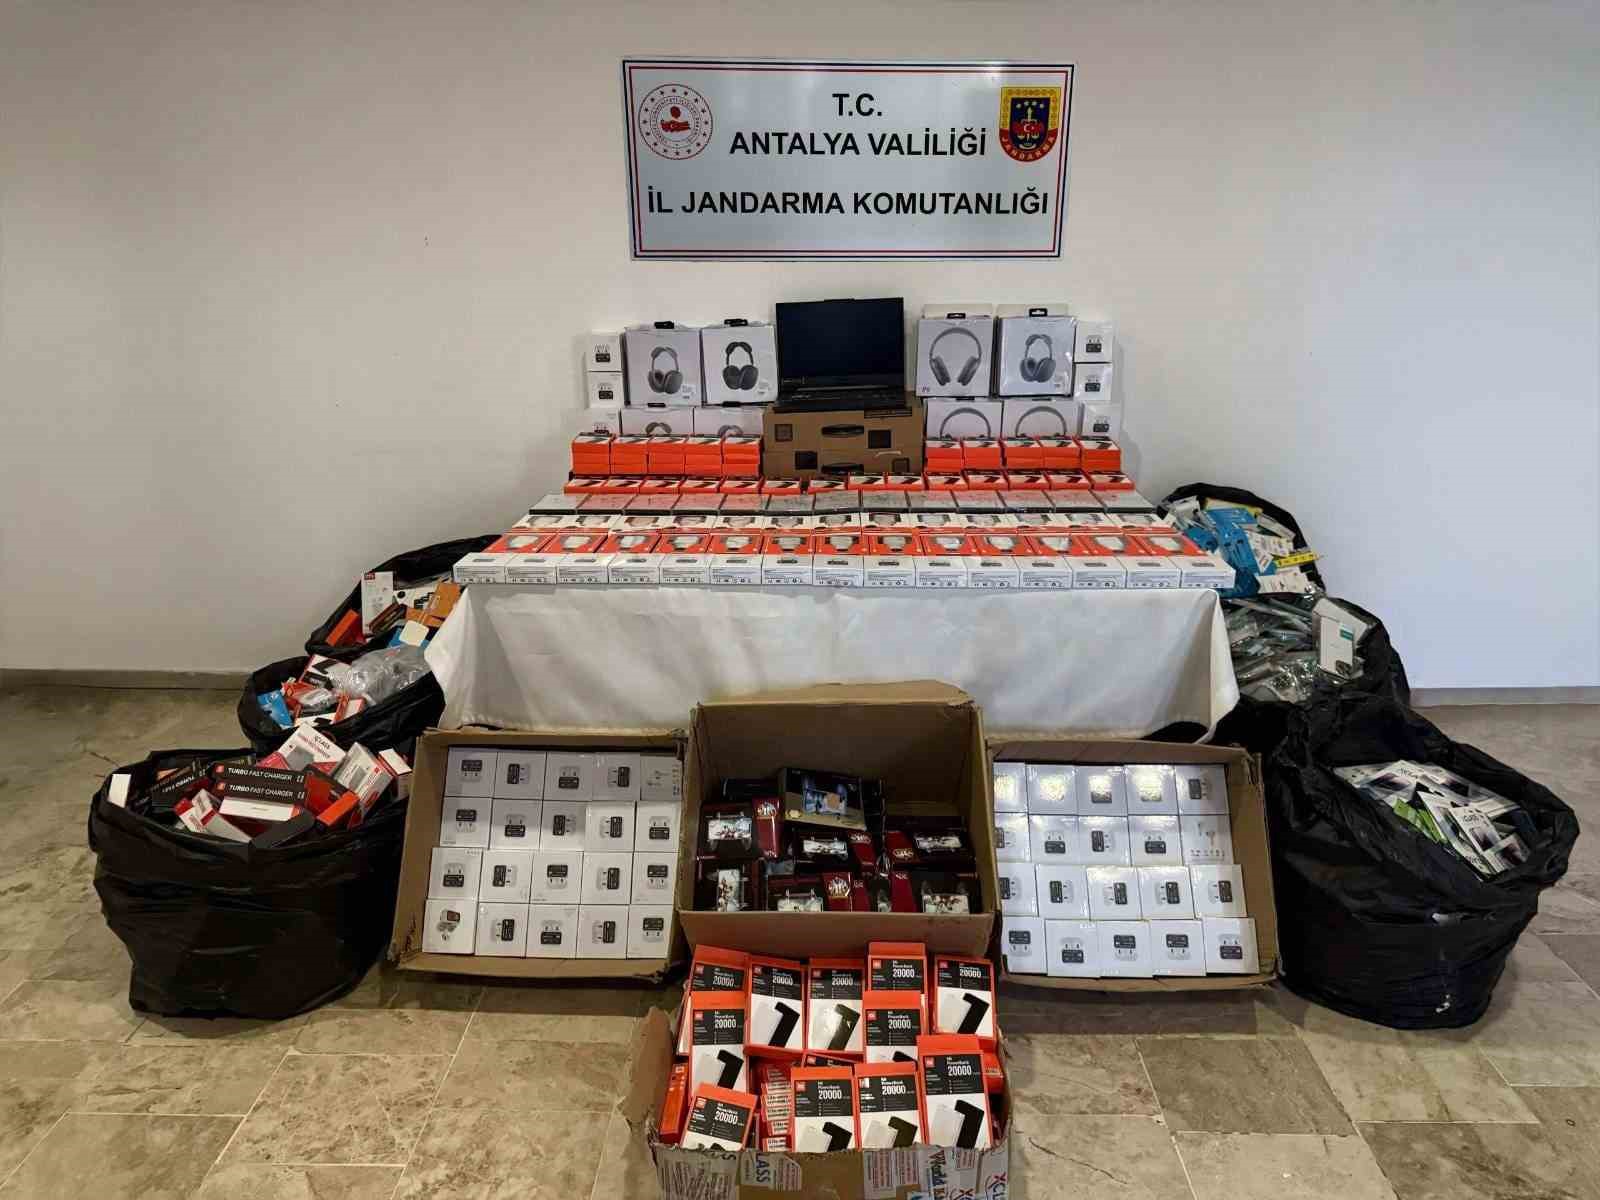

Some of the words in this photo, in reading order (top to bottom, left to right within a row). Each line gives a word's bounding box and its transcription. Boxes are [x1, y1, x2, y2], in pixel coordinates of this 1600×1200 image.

[832, 93, 882, 117] T.C.
[729, 131, 860, 156] ANTALYA
[868, 127, 986, 156] VALİLİĞİ
[647, 185, 674, 214] İL
[681, 191, 845, 214] JANDARMA
[853, 186, 1049, 215] KOMUTANLIĞI
[228, 767, 249, 776] TURBO
[249, 770, 264, 778] FAST
[263, 772, 293, 781] CHARGER
[229, 784, 250, 793] TURBO
[265, 788, 294, 798] CHARGER
[892, 968, 915, 978] 20000
[959, 969, 982, 978] 20000
[772, 975, 794, 986] 20000
[832, 977, 853, 986] 20000
[714, 1018, 736, 1029] 20000
[888, 1018, 911, 1029] 20000
[948, 1065, 972, 1076] 20000
[818, 1089, 842, 1100] 20000
[881, 1085, 906, 1096] 20000
[714, 1110, 738, 1124] 20000
